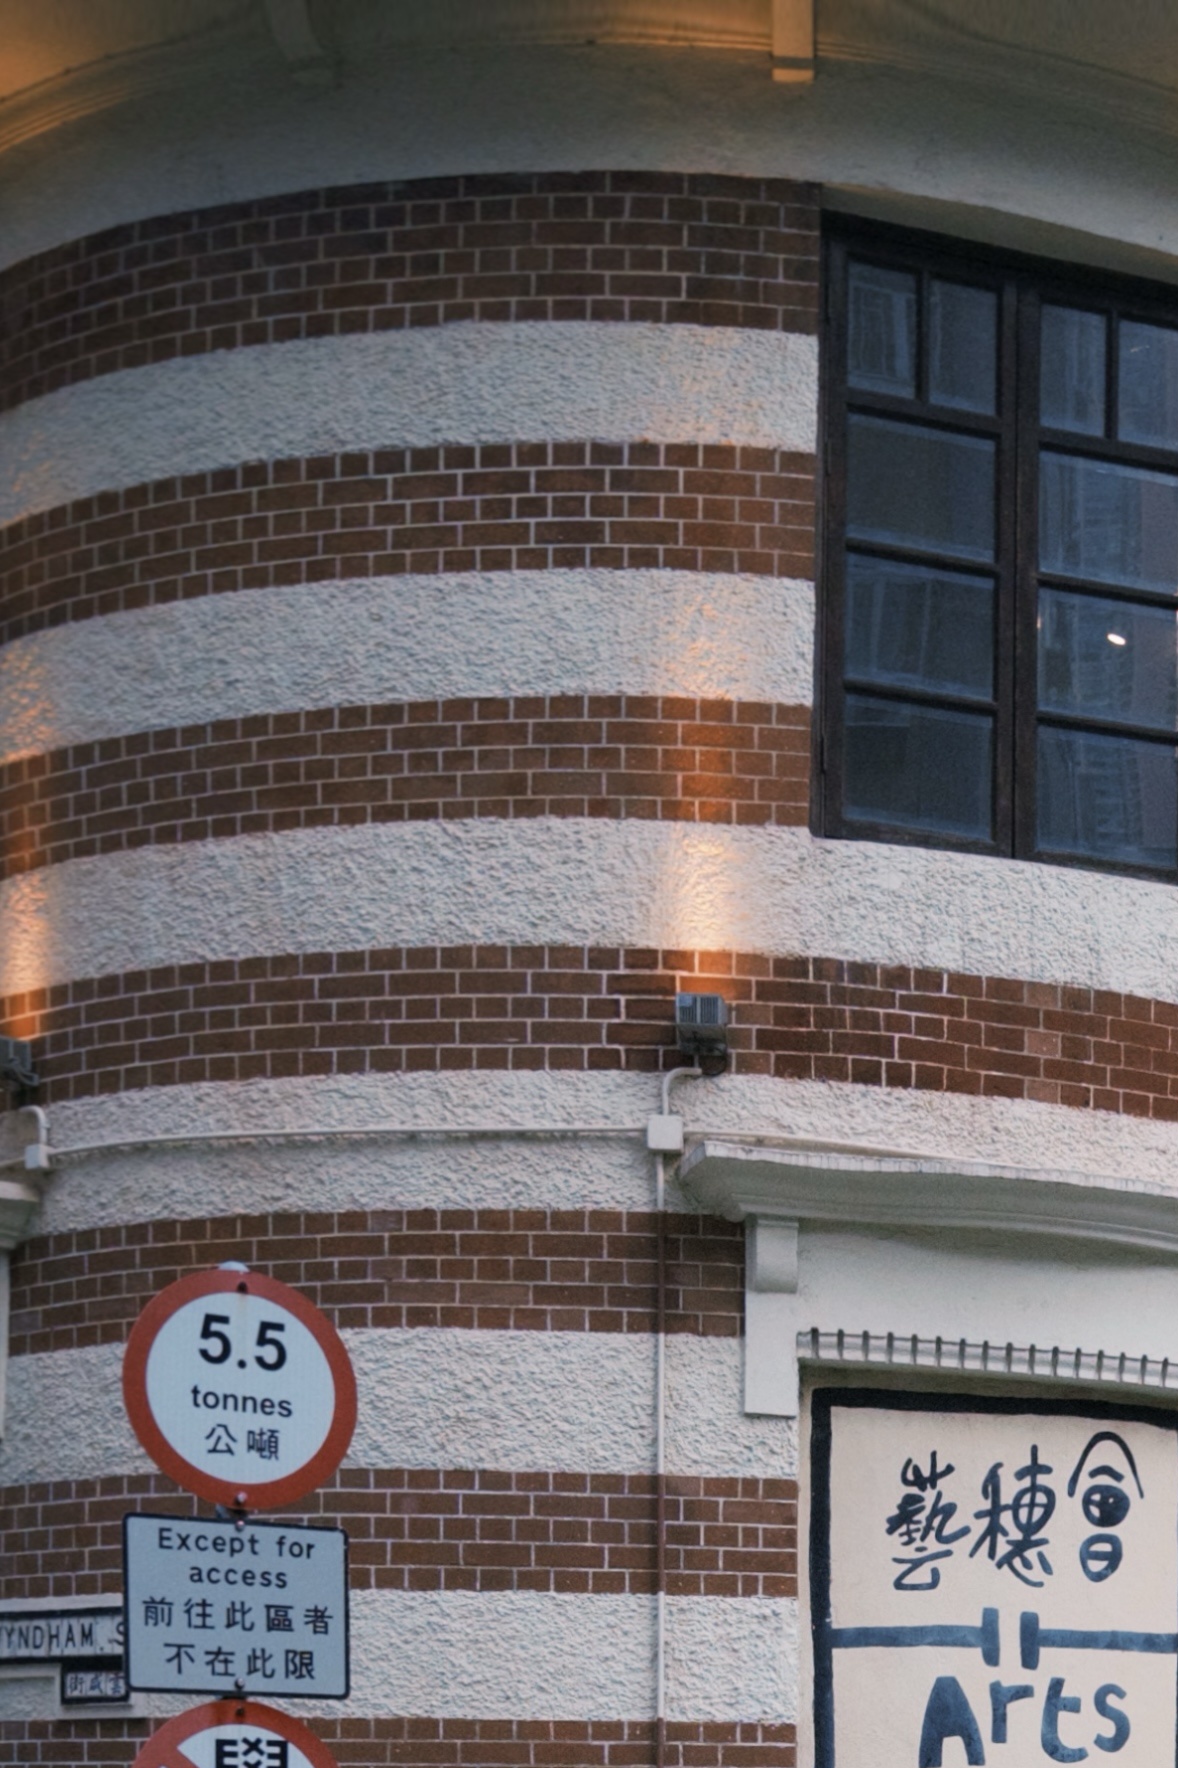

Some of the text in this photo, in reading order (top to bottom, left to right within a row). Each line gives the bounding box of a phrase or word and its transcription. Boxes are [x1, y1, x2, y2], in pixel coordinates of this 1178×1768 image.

[198, 1313, 287, 1371] 5.5
[191, 1385, 293, 1418] tonnes
[205, 1424, 280, 1461] 公噸
[158, 1527, 315, 1559] Except for
[189, 1565, 287, 1588] access
[142, 1596, 334, 1635] 前往此區者
[163, 1642, 315, 1680] 不在此限
[918, 1675, 1131, 1768] Arts
